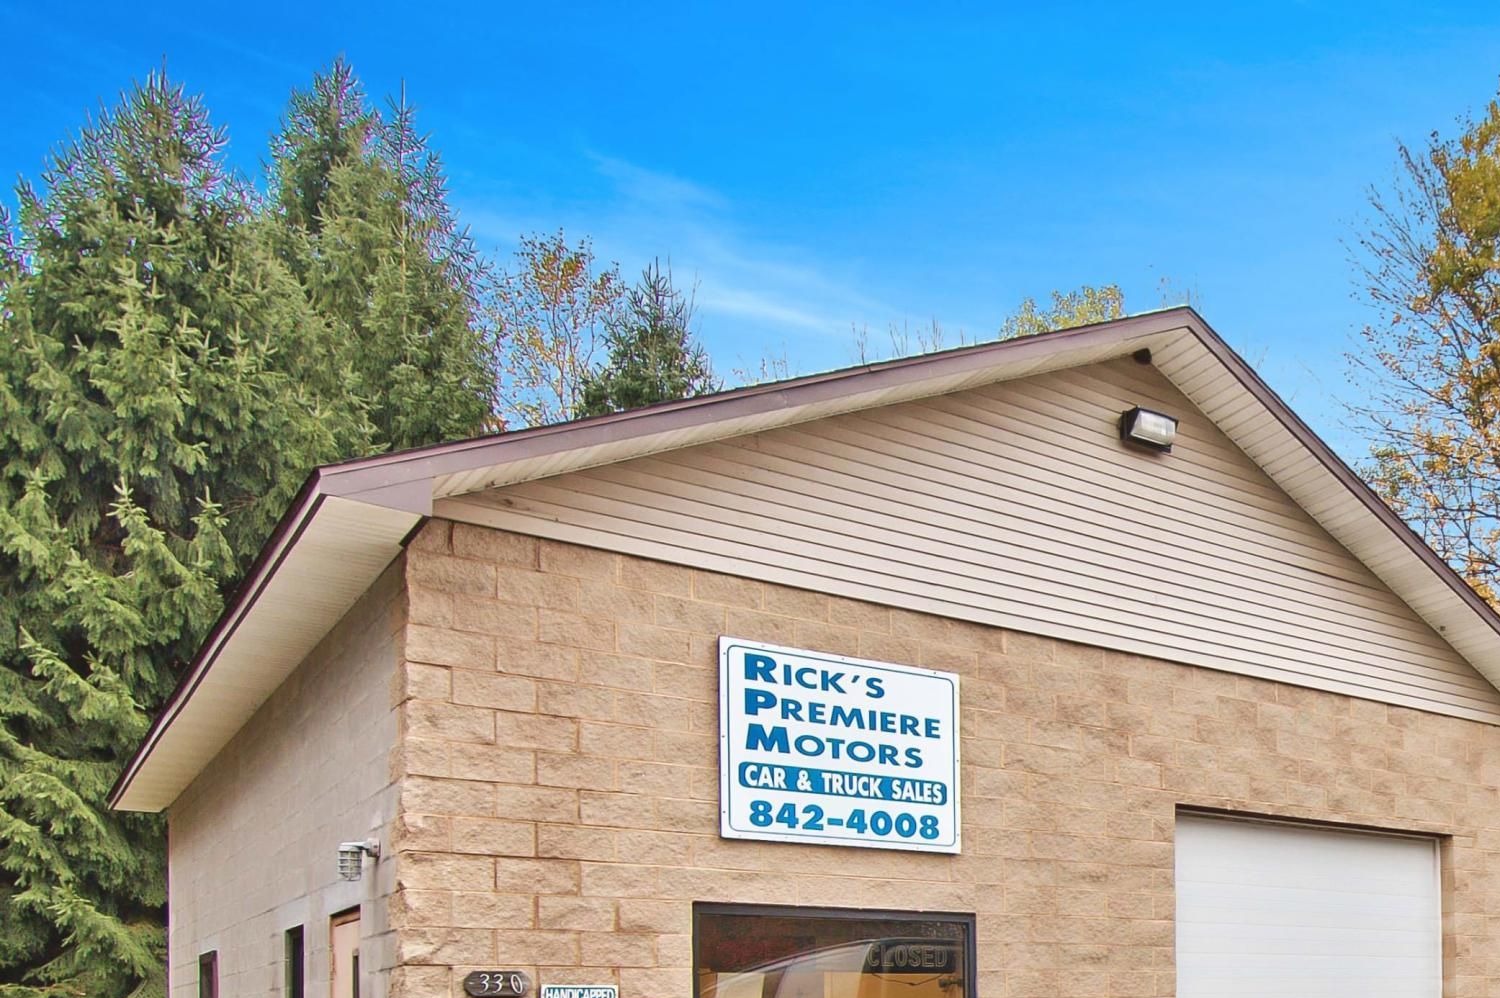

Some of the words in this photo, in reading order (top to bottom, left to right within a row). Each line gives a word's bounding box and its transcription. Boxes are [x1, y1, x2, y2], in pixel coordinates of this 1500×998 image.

[744, 653, 885, 698] RICK'S
[744, 687, 941, 739] PREMIERE
[745, 723, 923, 768] MOTORS
[744, 765, 787, 789] CAR
[796, 770, 812, 791] &
[821, 772, 883, 799] TRUCK
[892, 784, 943, 804] SALES
[749, 800, 940, 840] 842-4008
[867, 944, 948, 968] CLOSED
[479, 973, 523, 994] 330
